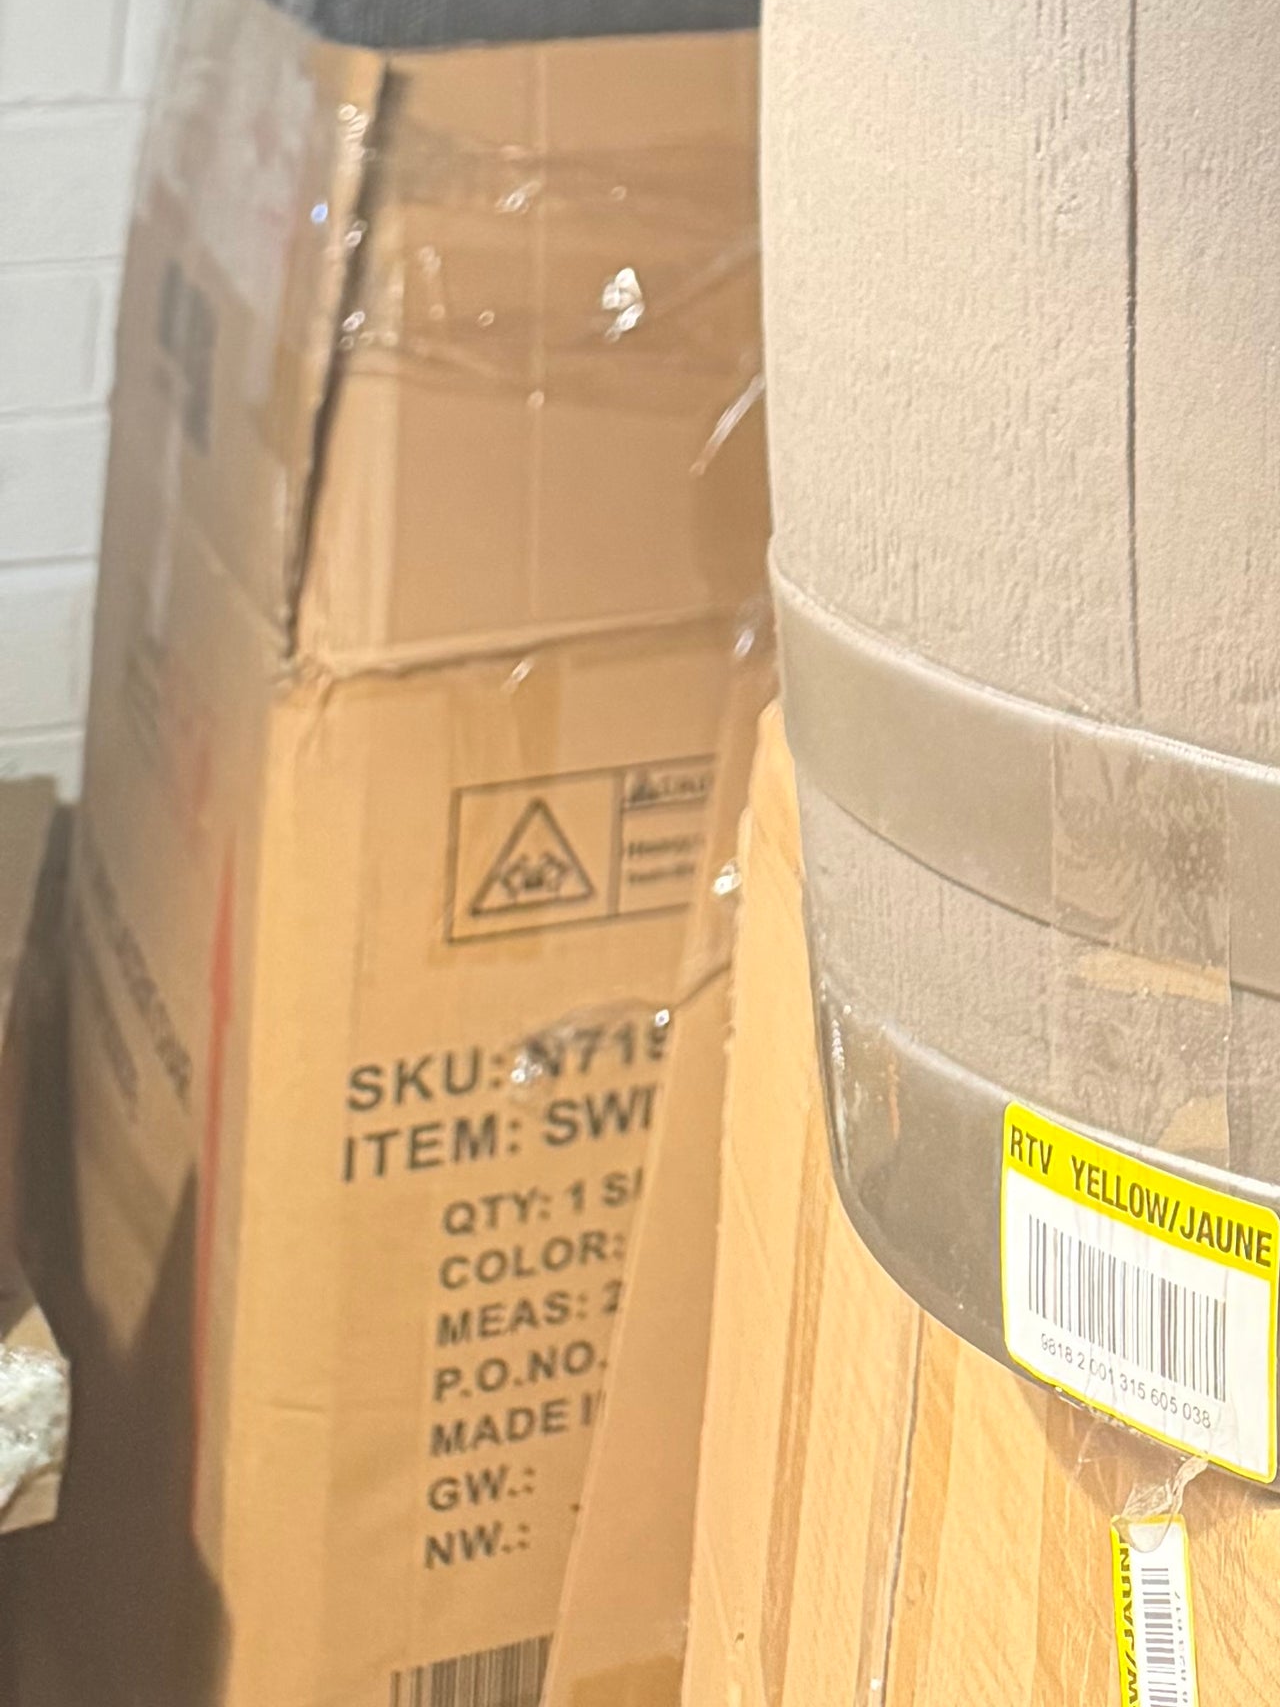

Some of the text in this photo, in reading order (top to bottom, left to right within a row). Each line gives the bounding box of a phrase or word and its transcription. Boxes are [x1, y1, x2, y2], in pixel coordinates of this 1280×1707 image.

[346, 1046, 504, 1112] SKU:
[342, 1113, 520, 1184] ITEM:
[443, 1187, 551, 1235] QTY:
[568, 1180, 586, 1213] 1
[1011, 1124, 1272, 1268] RTV YELLOW/JAUNE
[439, 1231, 626, 1290] COLOR:
[437, 1291, 588, 1347] MEAS:
[1041, 1333, 1073, 1364] 9818
[1077, 1352, 1085, 1370] 2
[1120, 1374, 1146, 1400] 315
[1151, 1388, 1178, 1414] 605
[1183, 1402, 1211, 1429] 038
[430, 1388, 607, 1457] MADE I
